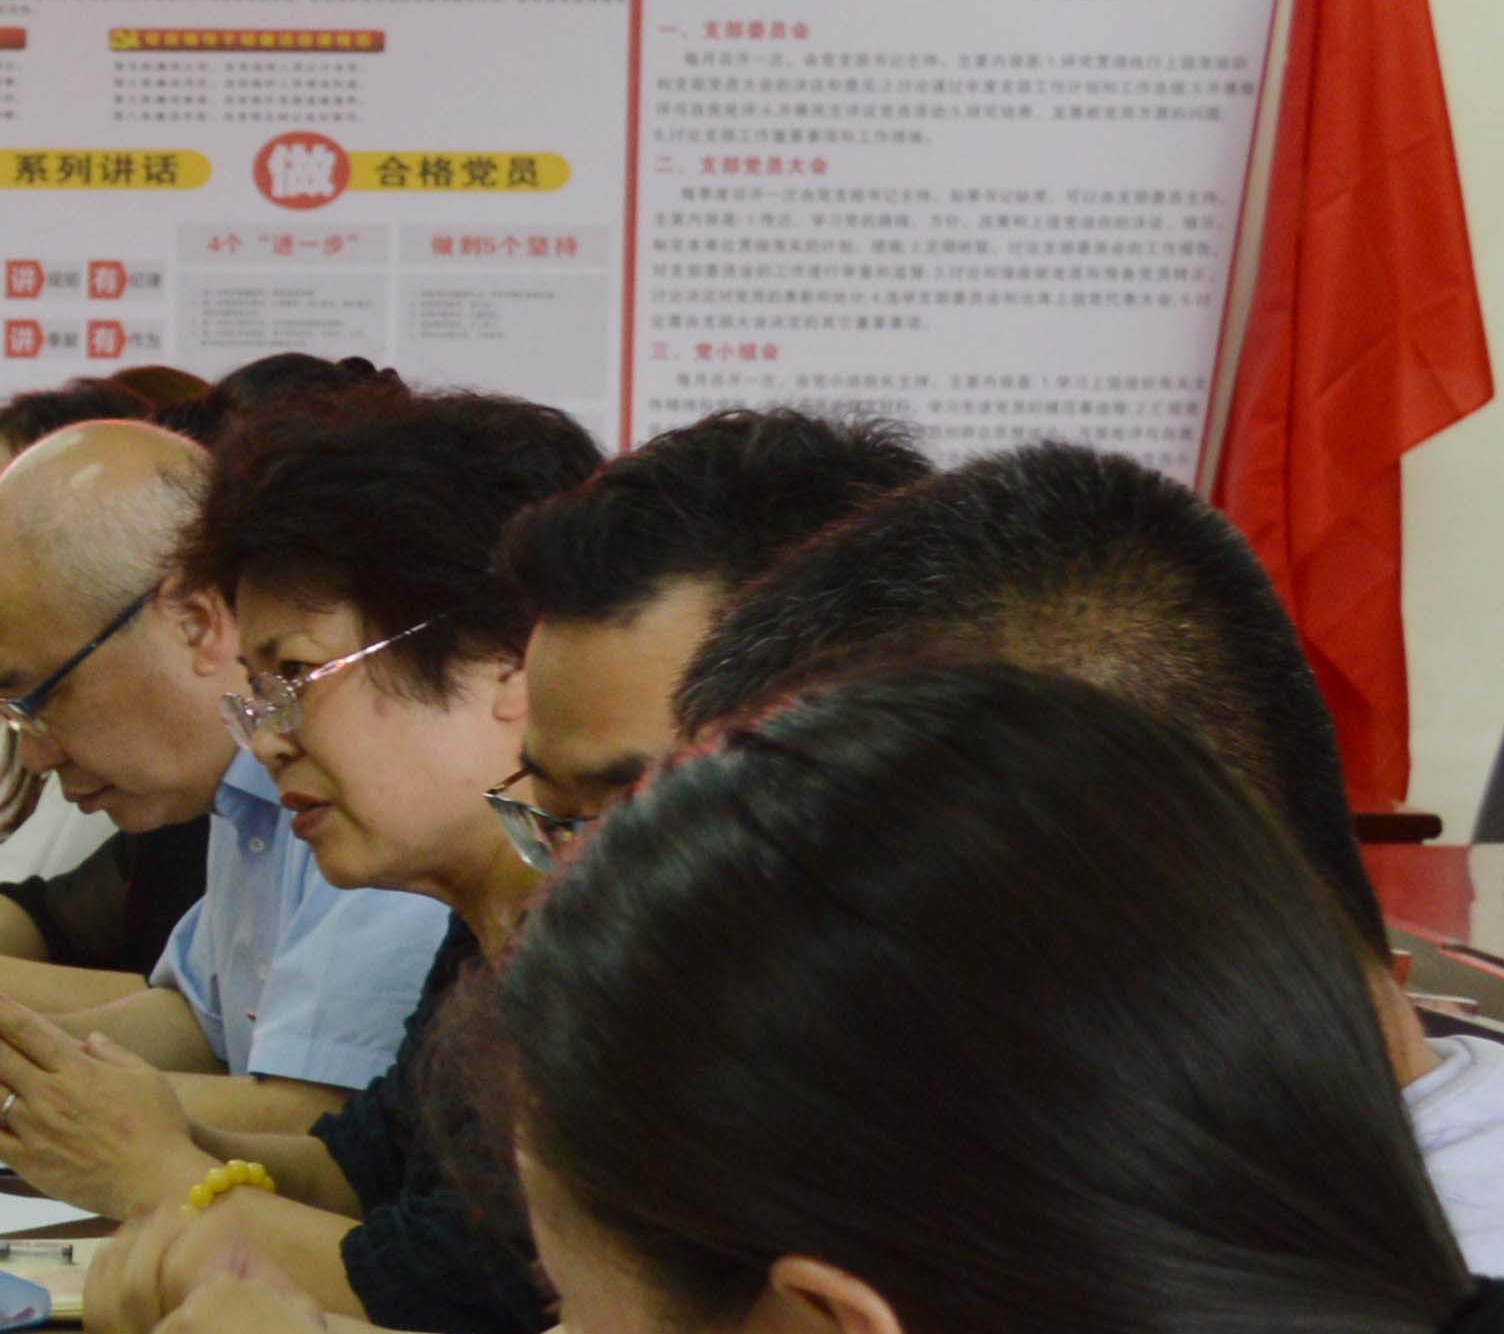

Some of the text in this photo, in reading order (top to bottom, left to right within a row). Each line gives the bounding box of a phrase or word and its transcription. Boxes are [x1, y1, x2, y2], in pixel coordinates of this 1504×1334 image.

[14, 153, 178, 185] 系列讲话
[375, 156, 540, 189] 合格党员
